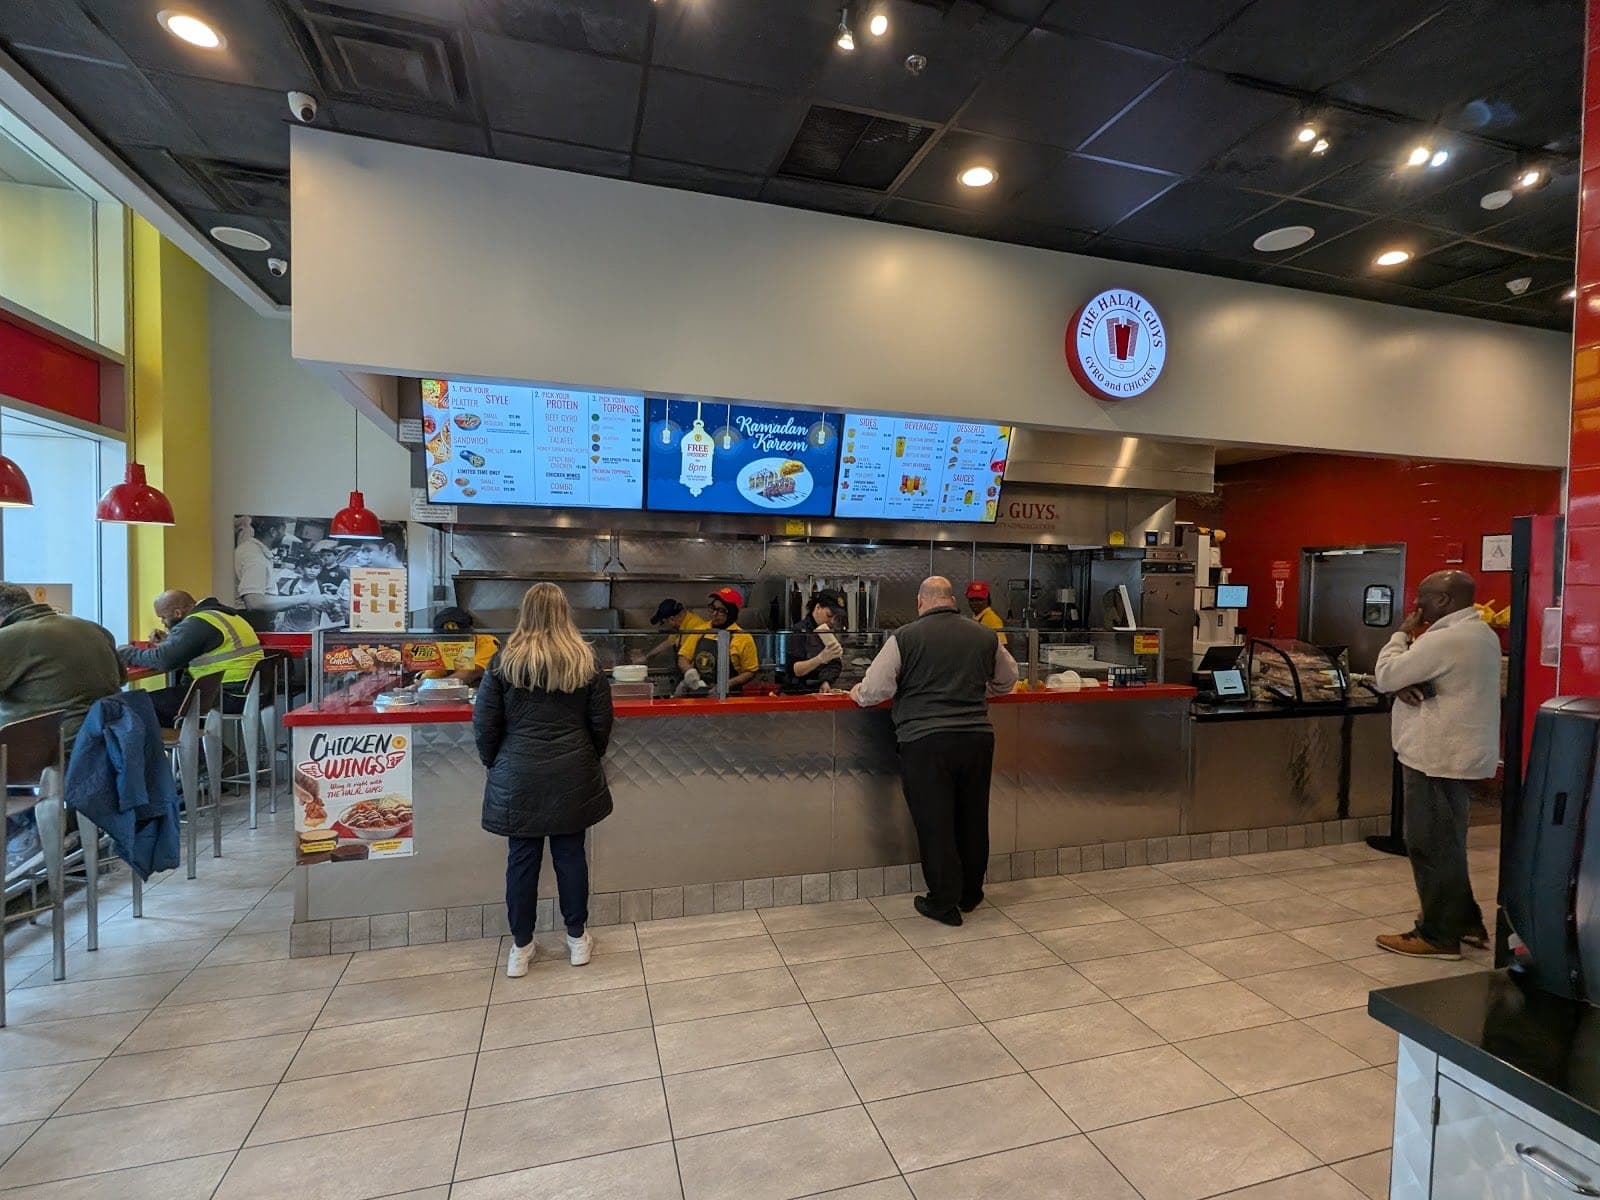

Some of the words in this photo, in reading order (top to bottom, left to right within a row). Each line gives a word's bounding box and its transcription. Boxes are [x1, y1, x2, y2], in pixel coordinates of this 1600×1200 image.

[1081, 307, 1099, 338] THE
[1098, 294, 1141, 312] HALAL
[1144, 310, 1163, 348] GUYS
[1085, 356, 1105, 382] GYRO
[1104, 380, 1120, 391] and
[1123, 364, 1157, 392] CHICKEN
[451, 398, 479, 408] PLATTER
[485, 394, 510, 405] STYLE
[546, 400, 578, 410] PROTEIN
[603, 403, 639, 414] TOPPINGS
[545, 414, 559, 422] BEEF
[560, 414, 578, 422] GYRO
[860, 418, 877, 428] SIDES
[547, 425, 575, 433] CHICKEN
[736, 416, 808, 436] Ramadan
[904, 422, 938, 432] BEVERAGES
[956, 424, 985, 434] DESSERTS
[454, 436, 488, 446] SANDWICH
[752, 434, 808, 452] Kareem
[687, 444, 708, 452] FREE
[952, 474, 976, 482] SAUCES
[550, 482, 573, 490] COMBO
[1009, 502, 1055, 520] GUYS
[309, 733, 393, 762] CHICKEN
[324, 754, 386, 780] WINGS
[354, 780, 368, 790] right
[327, 791, 340, 799] THE
[342, 788, 364, 798] HALAL
